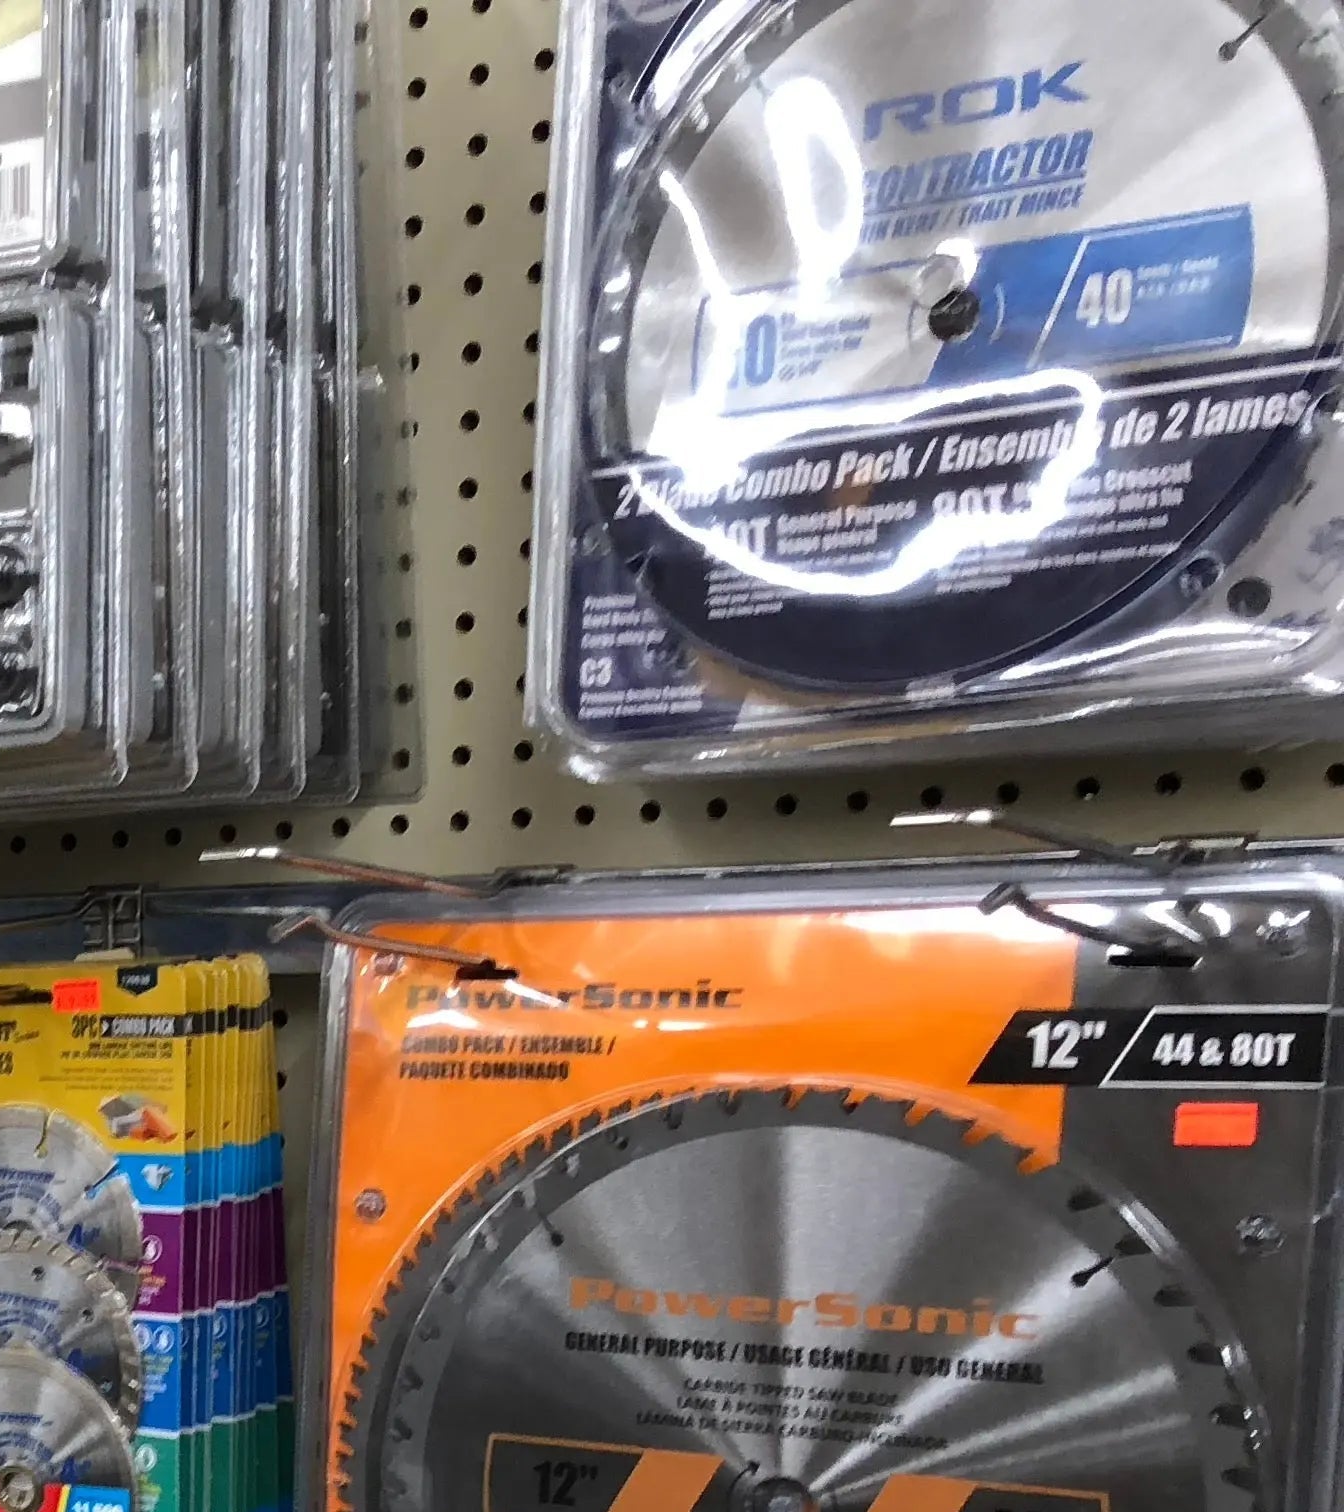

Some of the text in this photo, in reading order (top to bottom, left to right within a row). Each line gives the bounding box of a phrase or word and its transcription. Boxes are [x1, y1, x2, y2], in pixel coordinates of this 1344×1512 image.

[863, 60, 1090, 142] ROK
[1075, 266, 1133, 330] 40
[728, 455, 833, 504] Combo
[833, 438, 917, 490] Pack
[1110, 406, 1160, 450] de
[1160, 399, 1191, 443] 2
[1190, 390, 1313, 440] lames
[579, 657, 614, 688] C3
[406, 978, 745, 1011] PowerSonic
[1026, 1019, 1107, 1072] 12"
[1150, 1030, 1193, 1067] 44
[1227, 1031, 1297, 1069] 80T
[568, 1275, 1042, 1341] PowerSonic
[565, 1331, 643, 1355] GENERAL
[644, 1335, 727, 1361] PURPOSE
[743, 1340, 805, 1368] USAGE
[954, 1355, 1045, 1386] GENERAL
[533, 1459, 598, 1506] 12"
